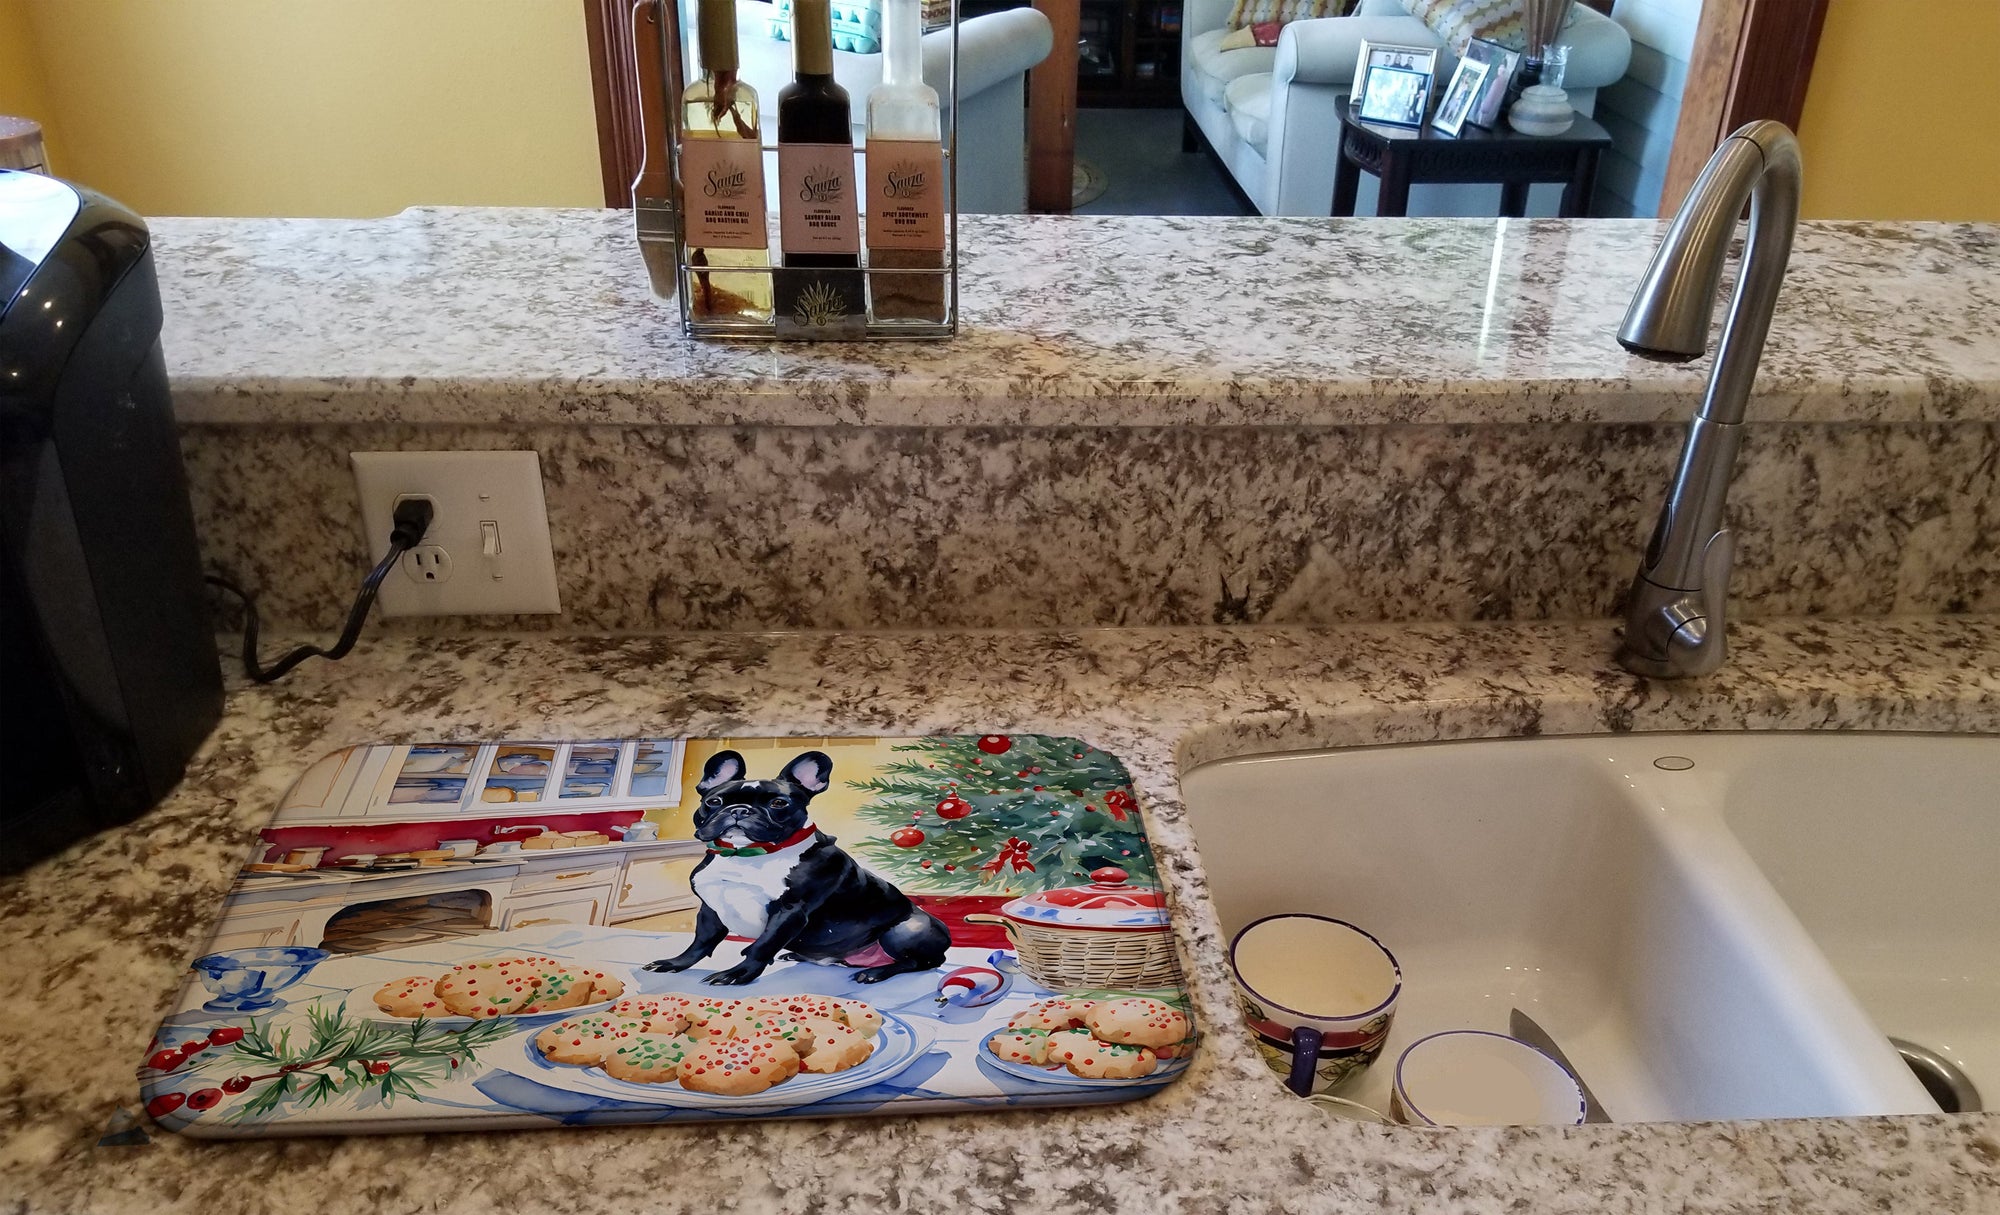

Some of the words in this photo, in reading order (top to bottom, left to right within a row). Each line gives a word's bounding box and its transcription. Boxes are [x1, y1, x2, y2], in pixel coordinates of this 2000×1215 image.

[703, 170, 745, 197] Sauza
[800, 175, 841, 202] Sauza
[883, 171, 924, 198] Sauza
